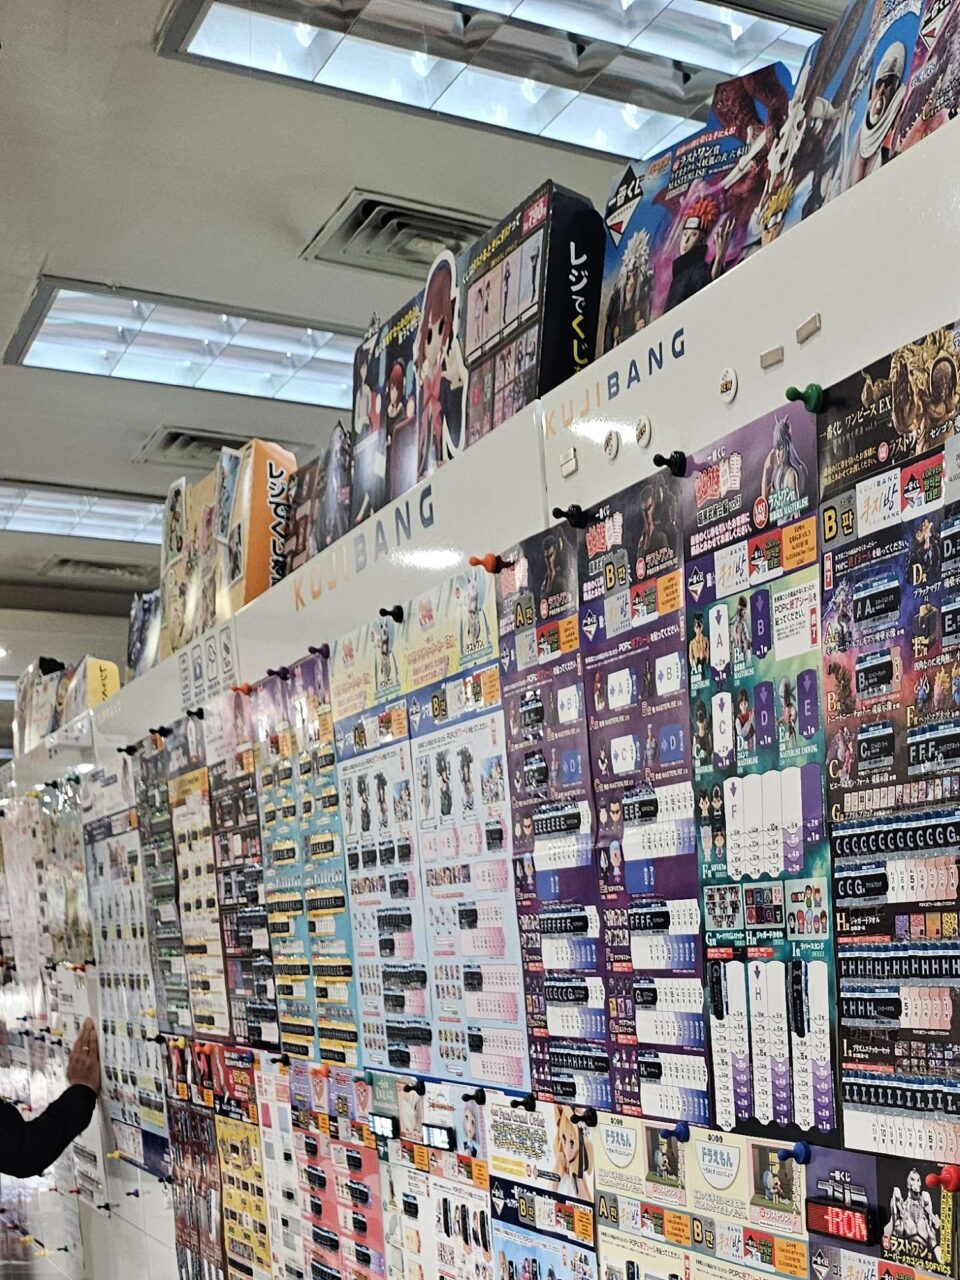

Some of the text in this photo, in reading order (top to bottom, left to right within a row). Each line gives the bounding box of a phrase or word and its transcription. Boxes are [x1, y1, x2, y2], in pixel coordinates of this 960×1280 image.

[545, 327, 687, 438] KUJIBANG
[823, 510, 853, 539] B 판
[606, 563, 616, 588] B
[516, 604, 525, 628] A
[693, 1219, 702, 1241] B
